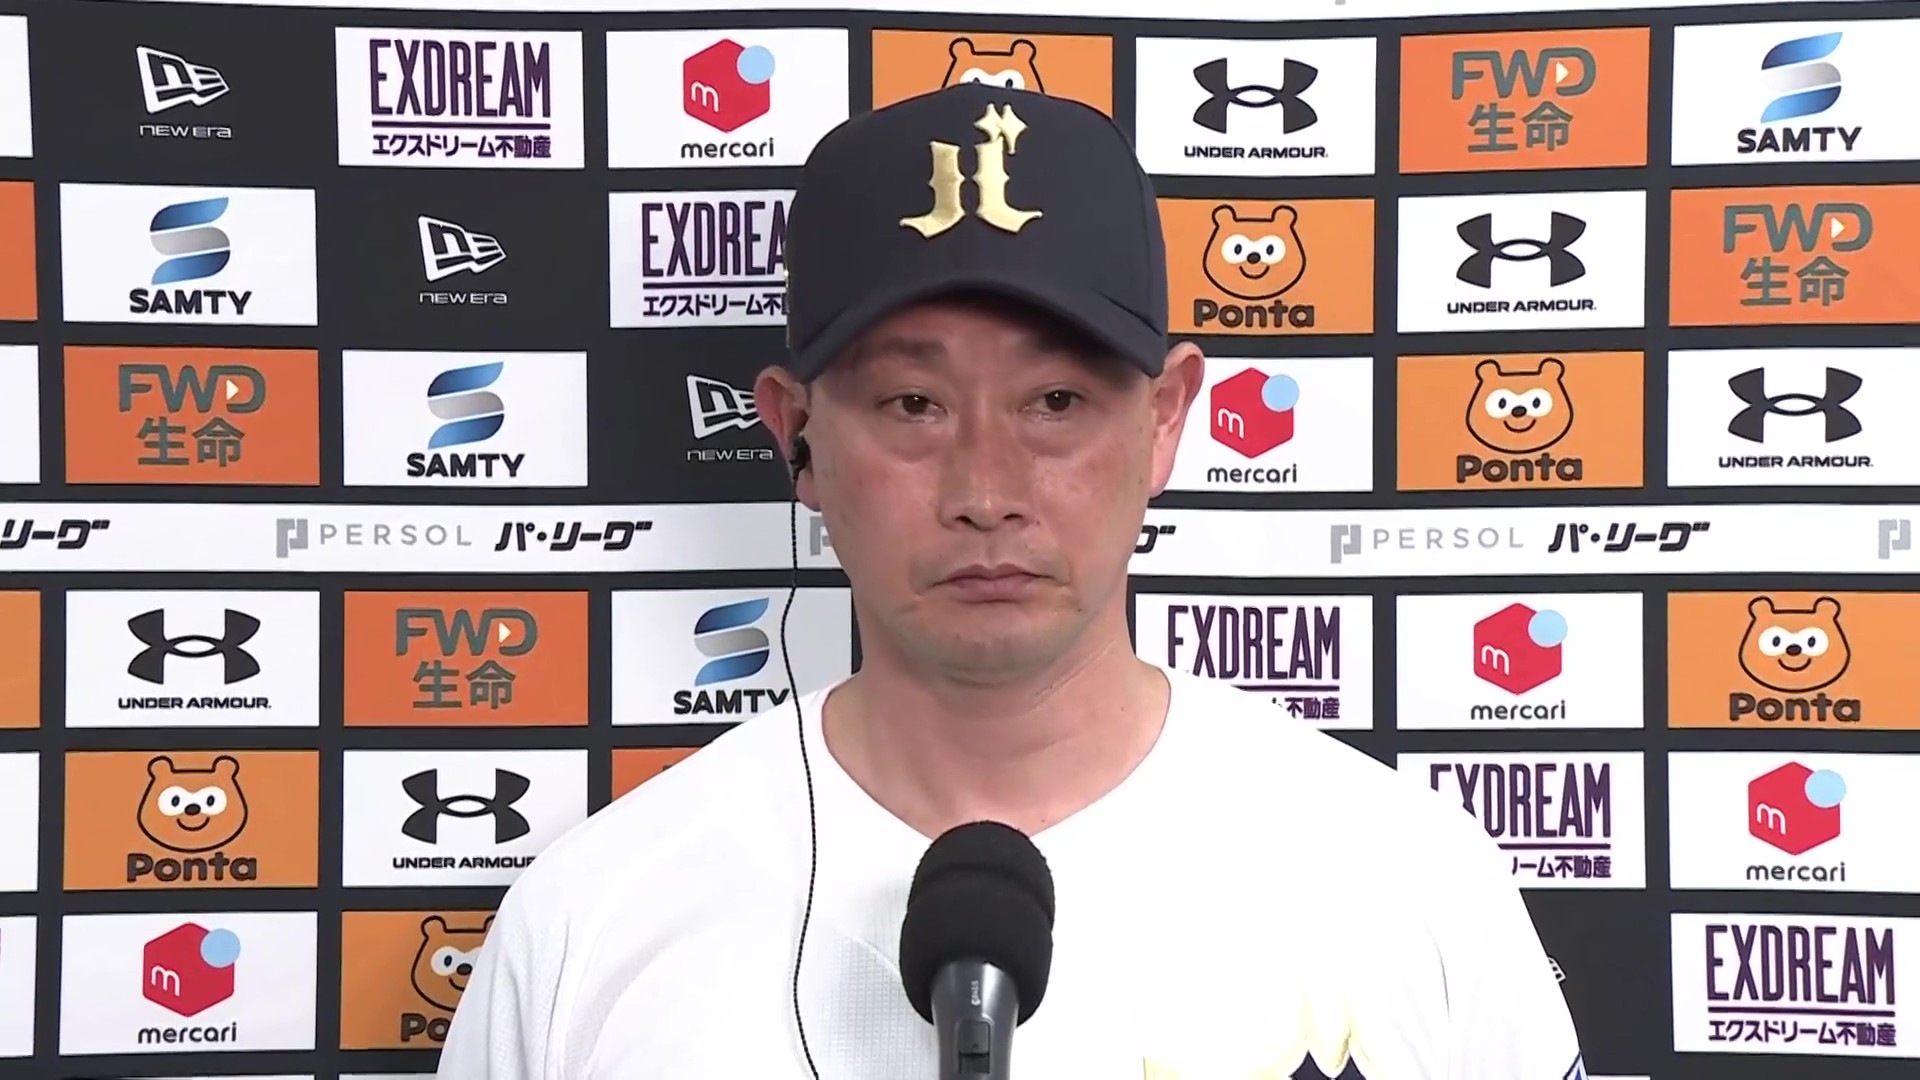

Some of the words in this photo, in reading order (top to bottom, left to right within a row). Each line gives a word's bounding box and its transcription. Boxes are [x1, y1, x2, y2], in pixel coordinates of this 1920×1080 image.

[370, 39, 550, 118] EXDREAM
[1452, 47, 1596, 100] FWD
[1468, 102, 1573, 152] 生命
[1738, 127, 1862, 153] SAMTY
[373, 134, 551, 158] エクスドリーム不動産
[681, 137, 774, 158] mercari
[1185, 146, 1245, 158] UNDER
[1724, 203, 1873, 253] FWD
[1740, 256, 1849, 306] 生命
[130, 288, 252, 315] SAMTY
[1193, 299, 1315, 328] Ponta
[1447, 301, 1510, 314] UNDER
[119, 364, 266, 414] FWD
[137, 416, 245, 467] 生命
[407, 453, 525, 477] SAMTY
[1207, 464, 1296, 483] mercari
[1456, 452, 1583, 483] Ponta
[1719, 456, 1783, 468] UNDER
[320, 524, 472, 546] PERSOL
[1374, 527, 1523, 549] PERSOL
[396, 608, 538, 656] FWD
[413, 660, 516, 709] 生命
[118, 698, 183, 709] UNDER
[1272, 697, 1340, 719] 不動産
[1471, 700, 1565, 720] mercari
[1729, 692, 1861, 722] Ponta
[126, 853, 257, 883] Ponta
[393, 857, 455, 868] UNDER
[1747, 862, 1845, 881] mercari
[1706, 925, 1896, 1006] EXDREAM
[138, 1022, 236, 1043] mercari
[1709, 1020, 1896, 1046] エクスドリーム不動産
